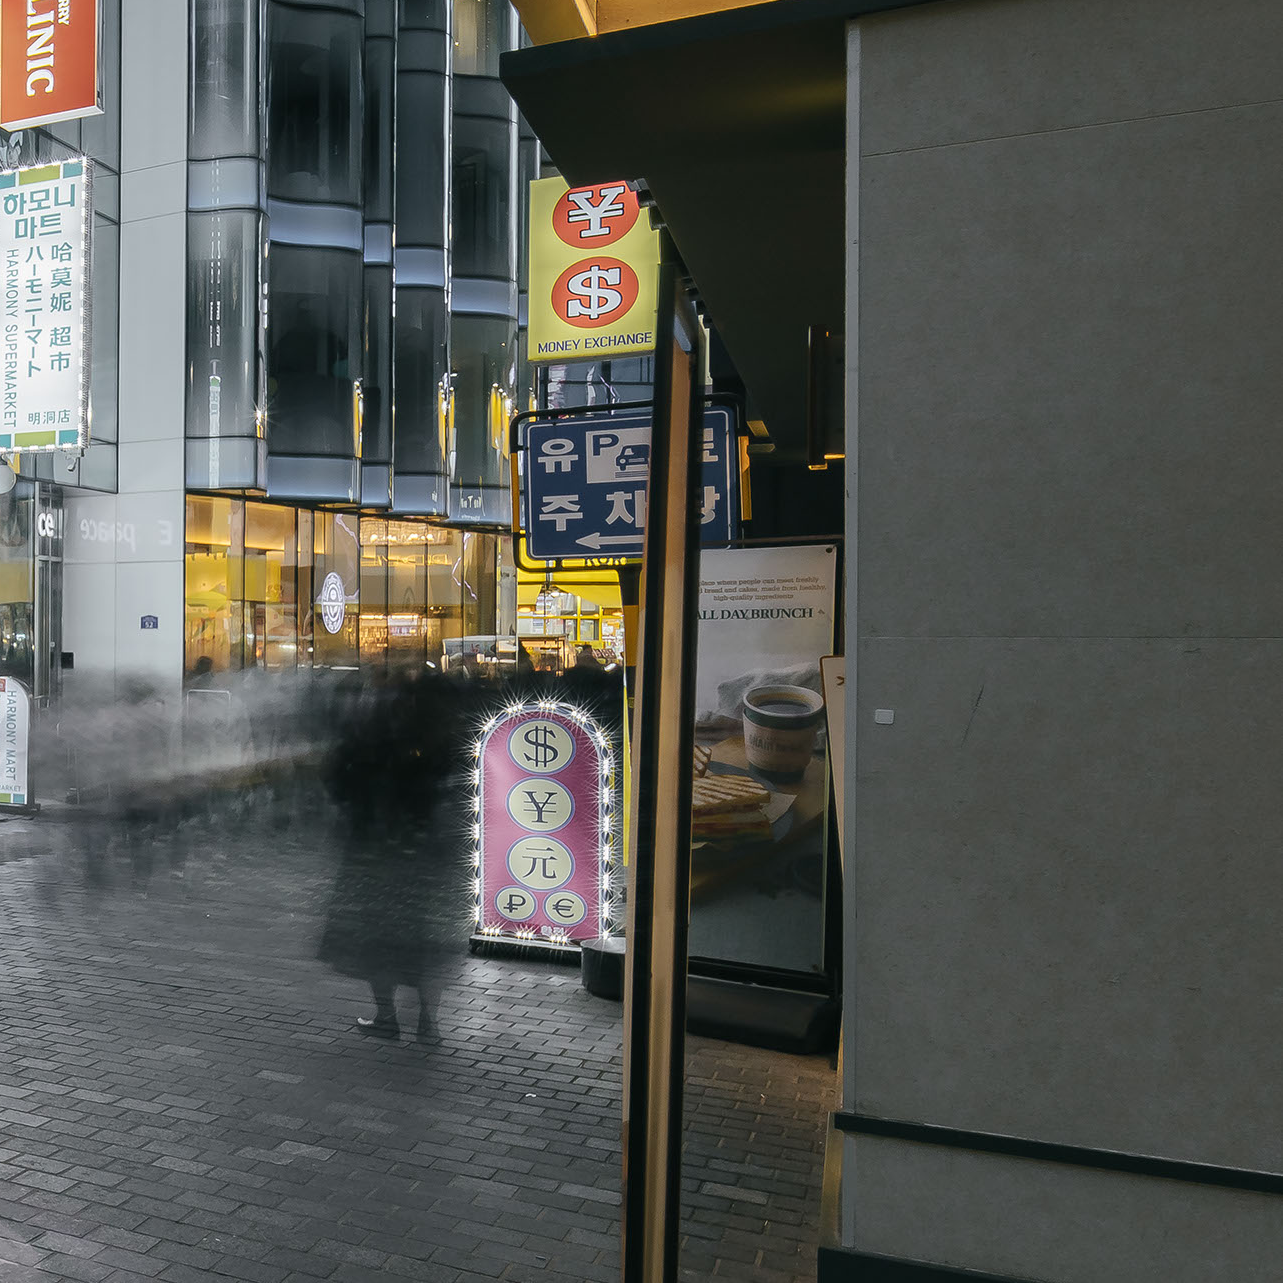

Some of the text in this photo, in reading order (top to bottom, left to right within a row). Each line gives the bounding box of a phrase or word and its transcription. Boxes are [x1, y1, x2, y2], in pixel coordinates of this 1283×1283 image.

[3, 182, 76, 216] 하모니
[14, 213, 63, 240] 마트
[25, 246, 43, 378] ハーモニーマート
[49, 242, 73, 372] 哈莫妮 超市
[4, 248, 19, 428] HARMONY SUPERMARKET
[537, 331, 652, 354] MONEY EXCHANGE
[28, 409, 70, 426] 明洞店
[721, 608, 750, 620] DAY
[751, 607, 814, 619] BRUNCH
[5, 690, 17, 781] HARMONY MART
[522, 847, 558, 879] 元
